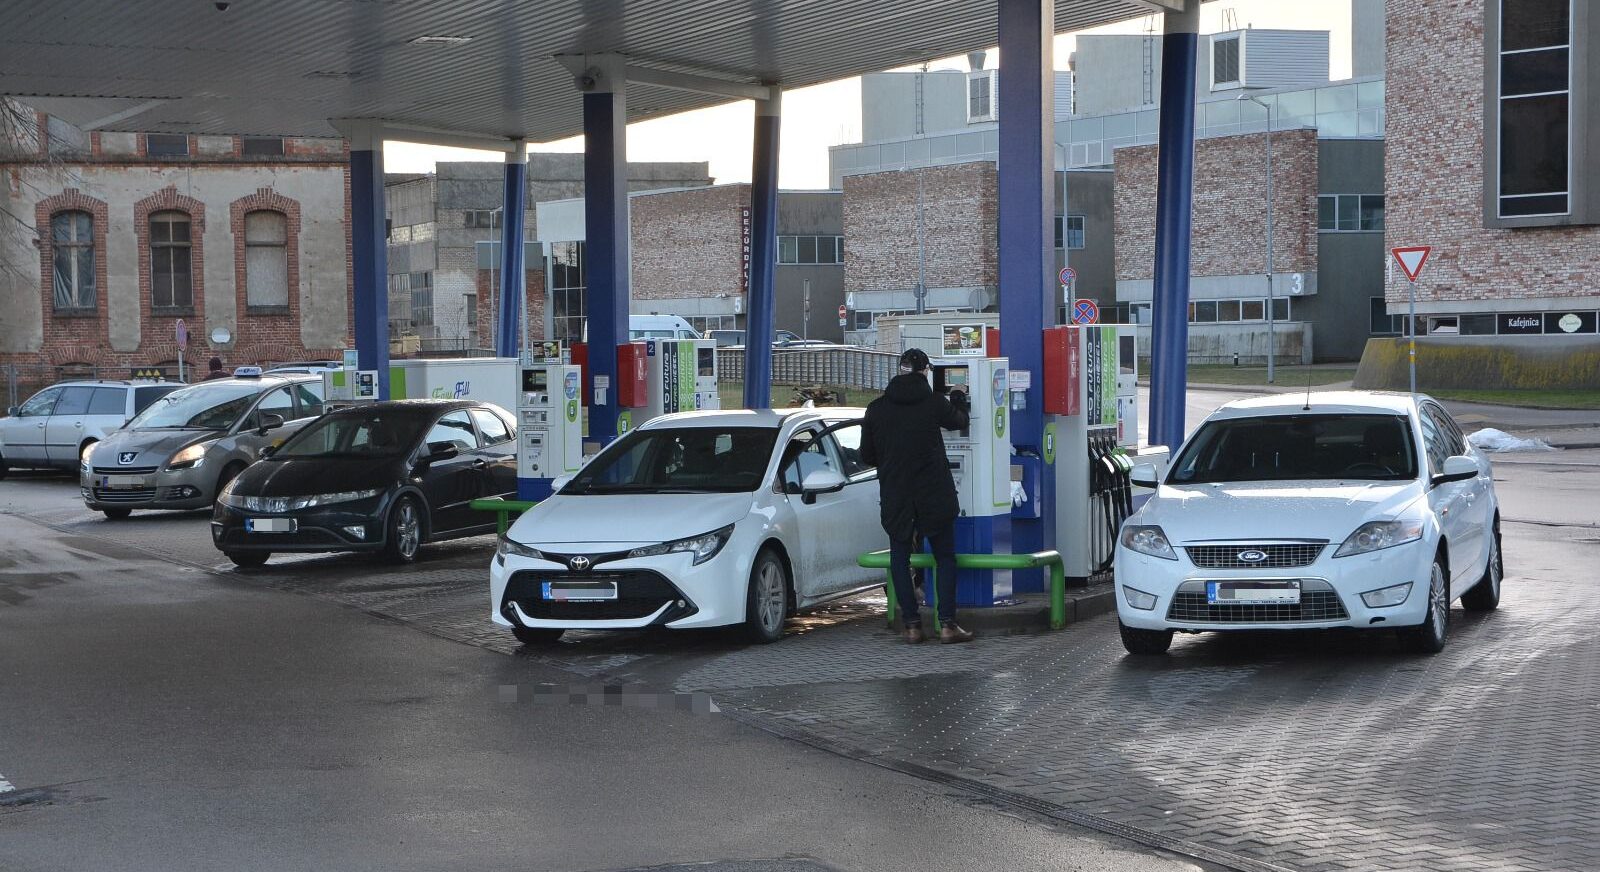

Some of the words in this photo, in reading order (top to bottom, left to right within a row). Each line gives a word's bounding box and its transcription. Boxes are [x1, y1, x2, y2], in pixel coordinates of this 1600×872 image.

[1292, 273, 1302, 294] 3
[735, 298, 741, 313] 5
[847, 291, 854, 309] 4
[1508, 316, 1540, 329] Kafejnīca
[648, 344, 654, 353] 2
[454, 381, 471, 399] Fill
